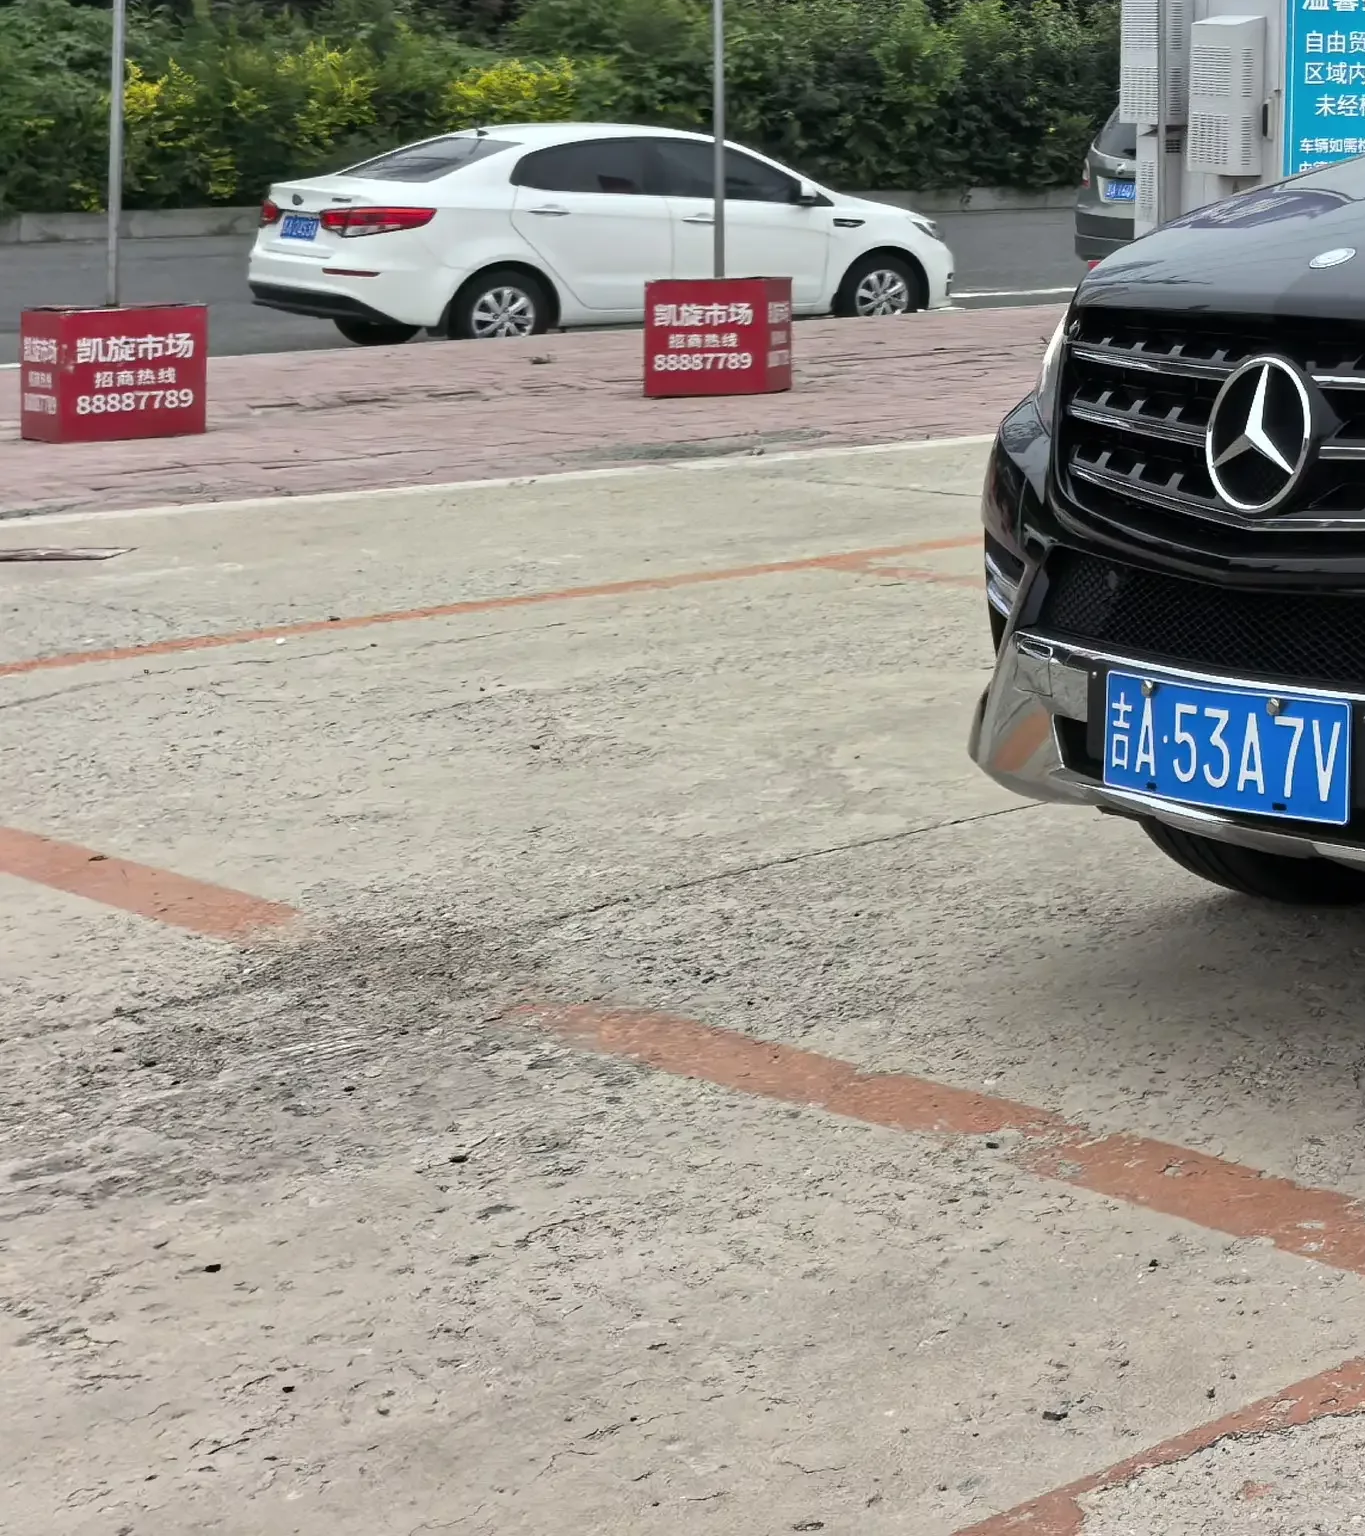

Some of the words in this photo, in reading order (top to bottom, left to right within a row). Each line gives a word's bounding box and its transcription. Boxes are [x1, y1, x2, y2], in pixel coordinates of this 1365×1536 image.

[653, 302, 754, 327] 凯旋市场
[76, 332, 195, 364] 凯旋市场
[653, 352, 753, 372] 88887789
[94, 366, 177, 389] 招商热线
[76, 388, 194, 415] 88887789
